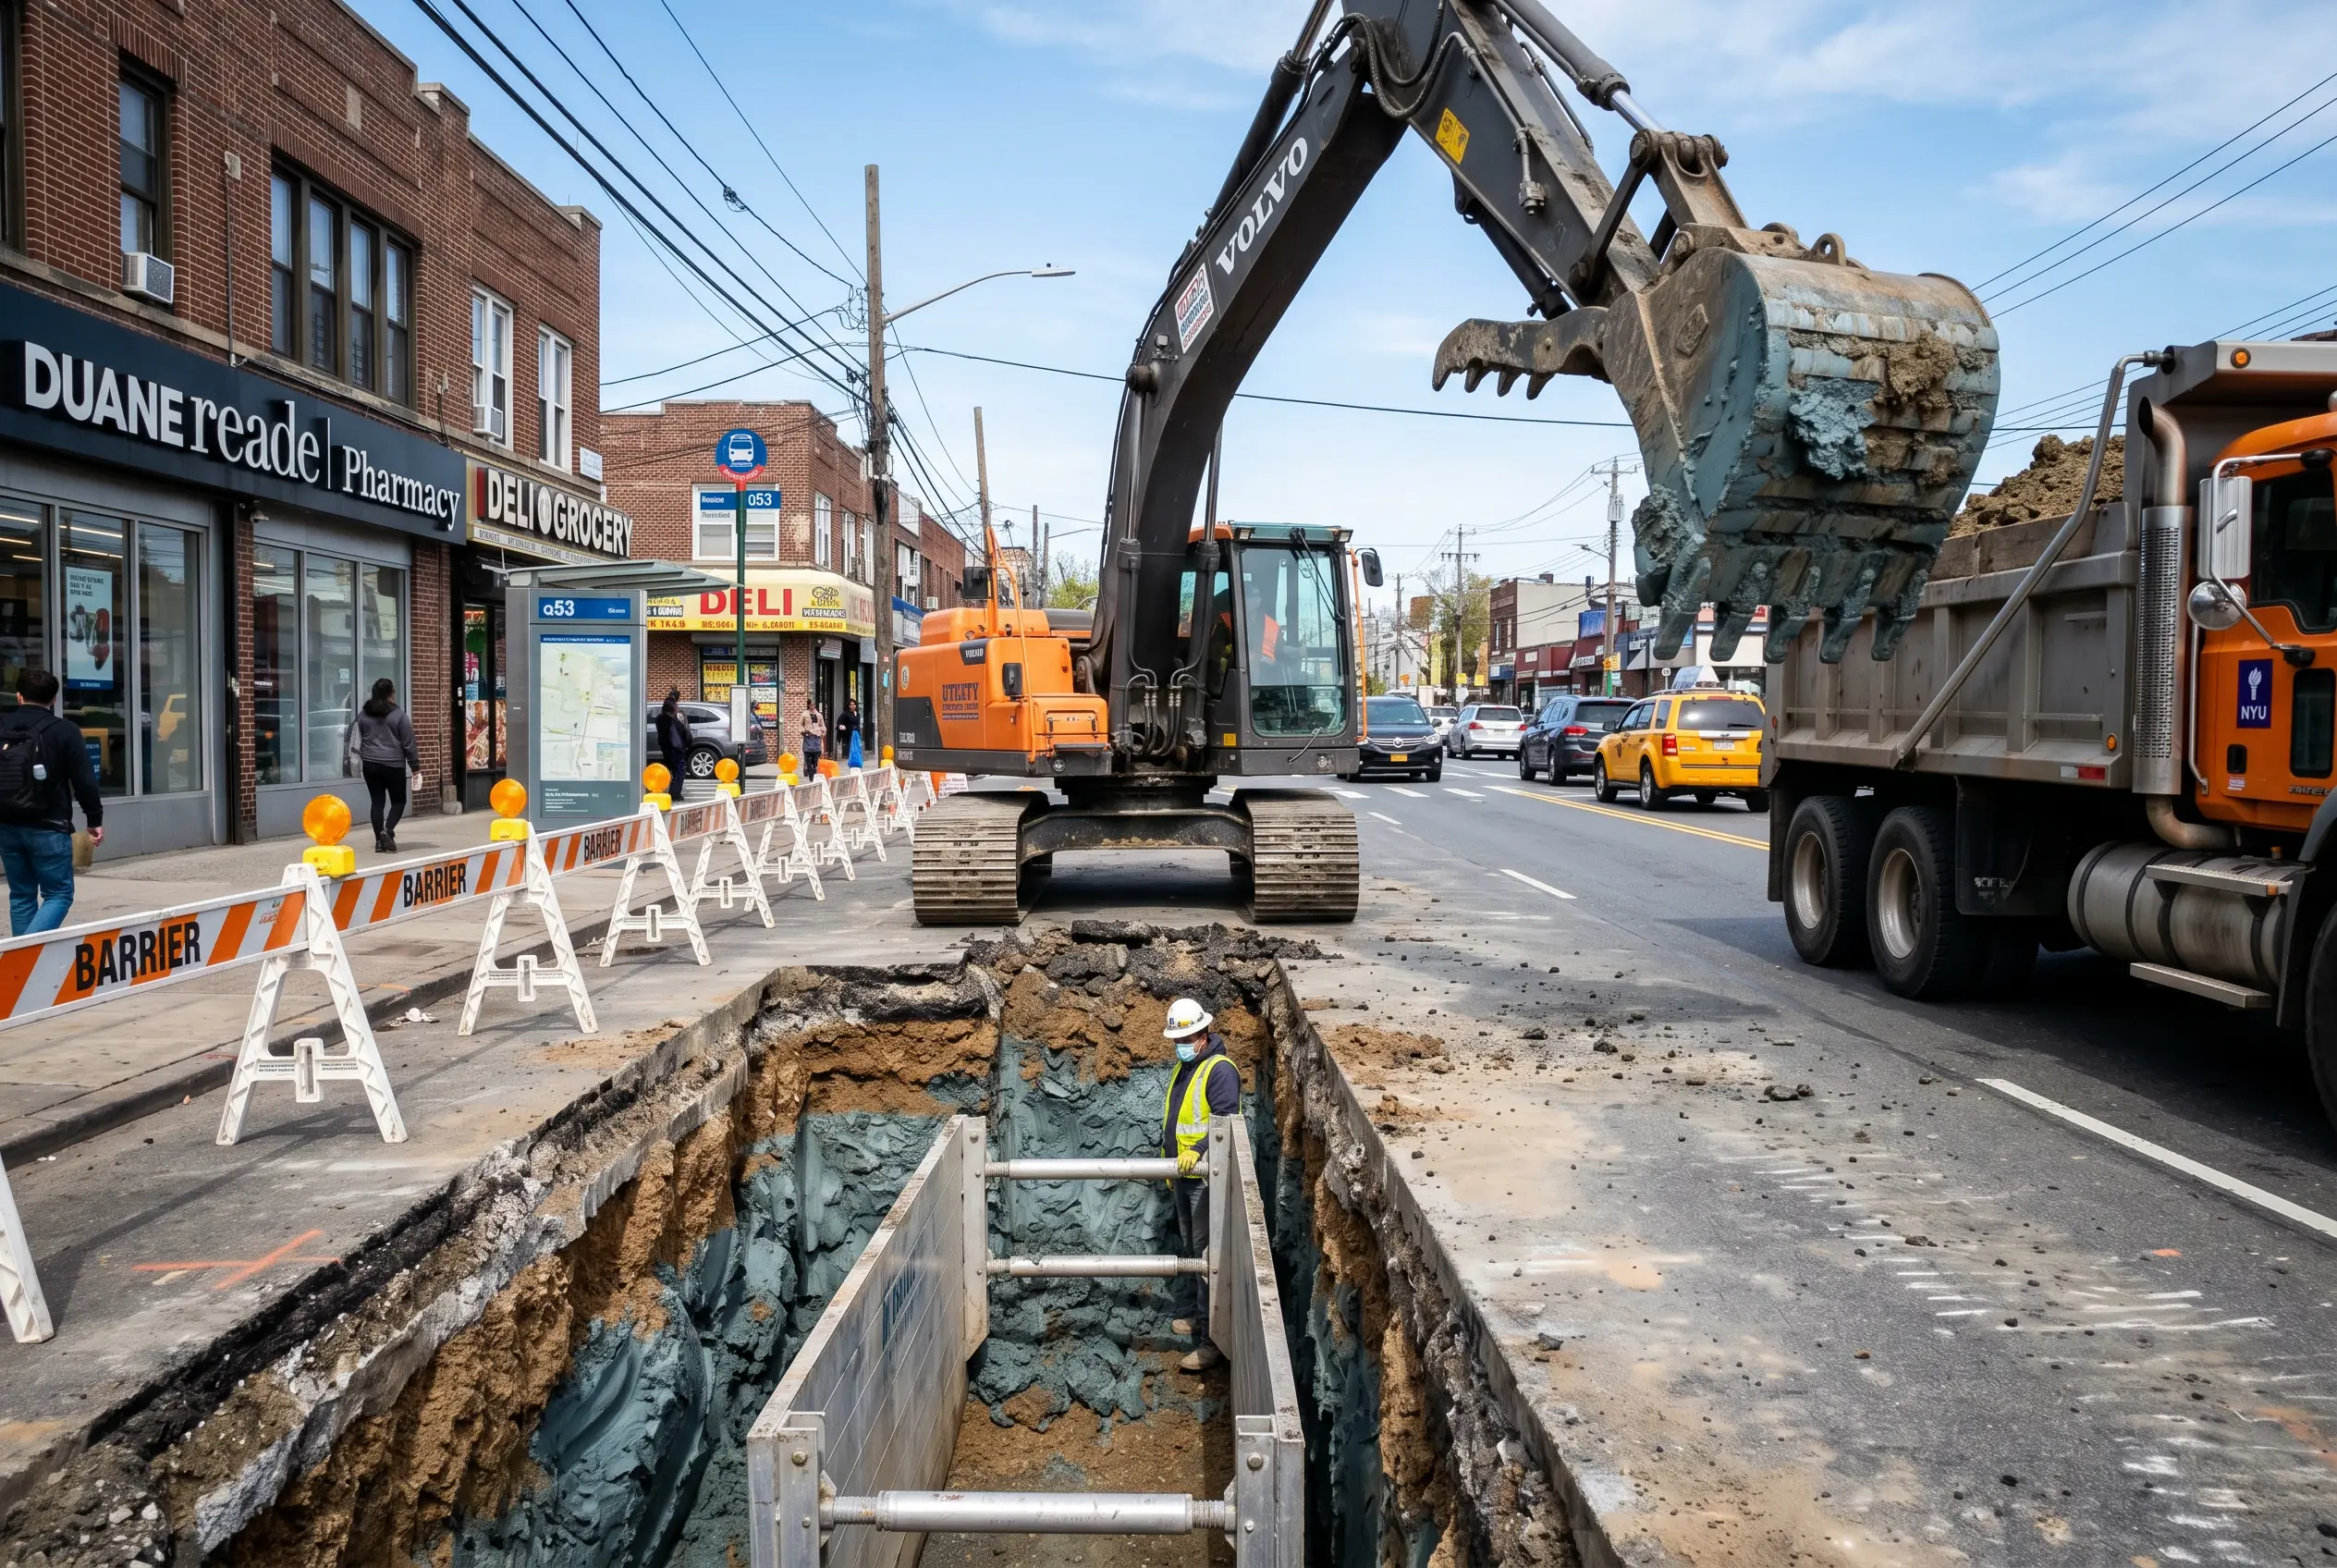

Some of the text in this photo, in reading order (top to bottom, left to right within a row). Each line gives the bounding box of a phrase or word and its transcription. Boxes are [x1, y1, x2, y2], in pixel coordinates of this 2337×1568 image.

[1216, 137, 1308, 275] VOLVO
[25, 340, 460, 532] DUANE reade Pharmacy
[488, 469, 534, 531] DELI
[554, 493, 633, 557] GROCERY
[543, 600, 575, 617] Q53
[700, 588, 792, 615] DELI
[2241, 705, 2268, 719] NYU
[583, 829, 621, 862] BARRIER
[403, 863, 467, 908] BARRIER
[76, 921, 201, 992] BARRIER
